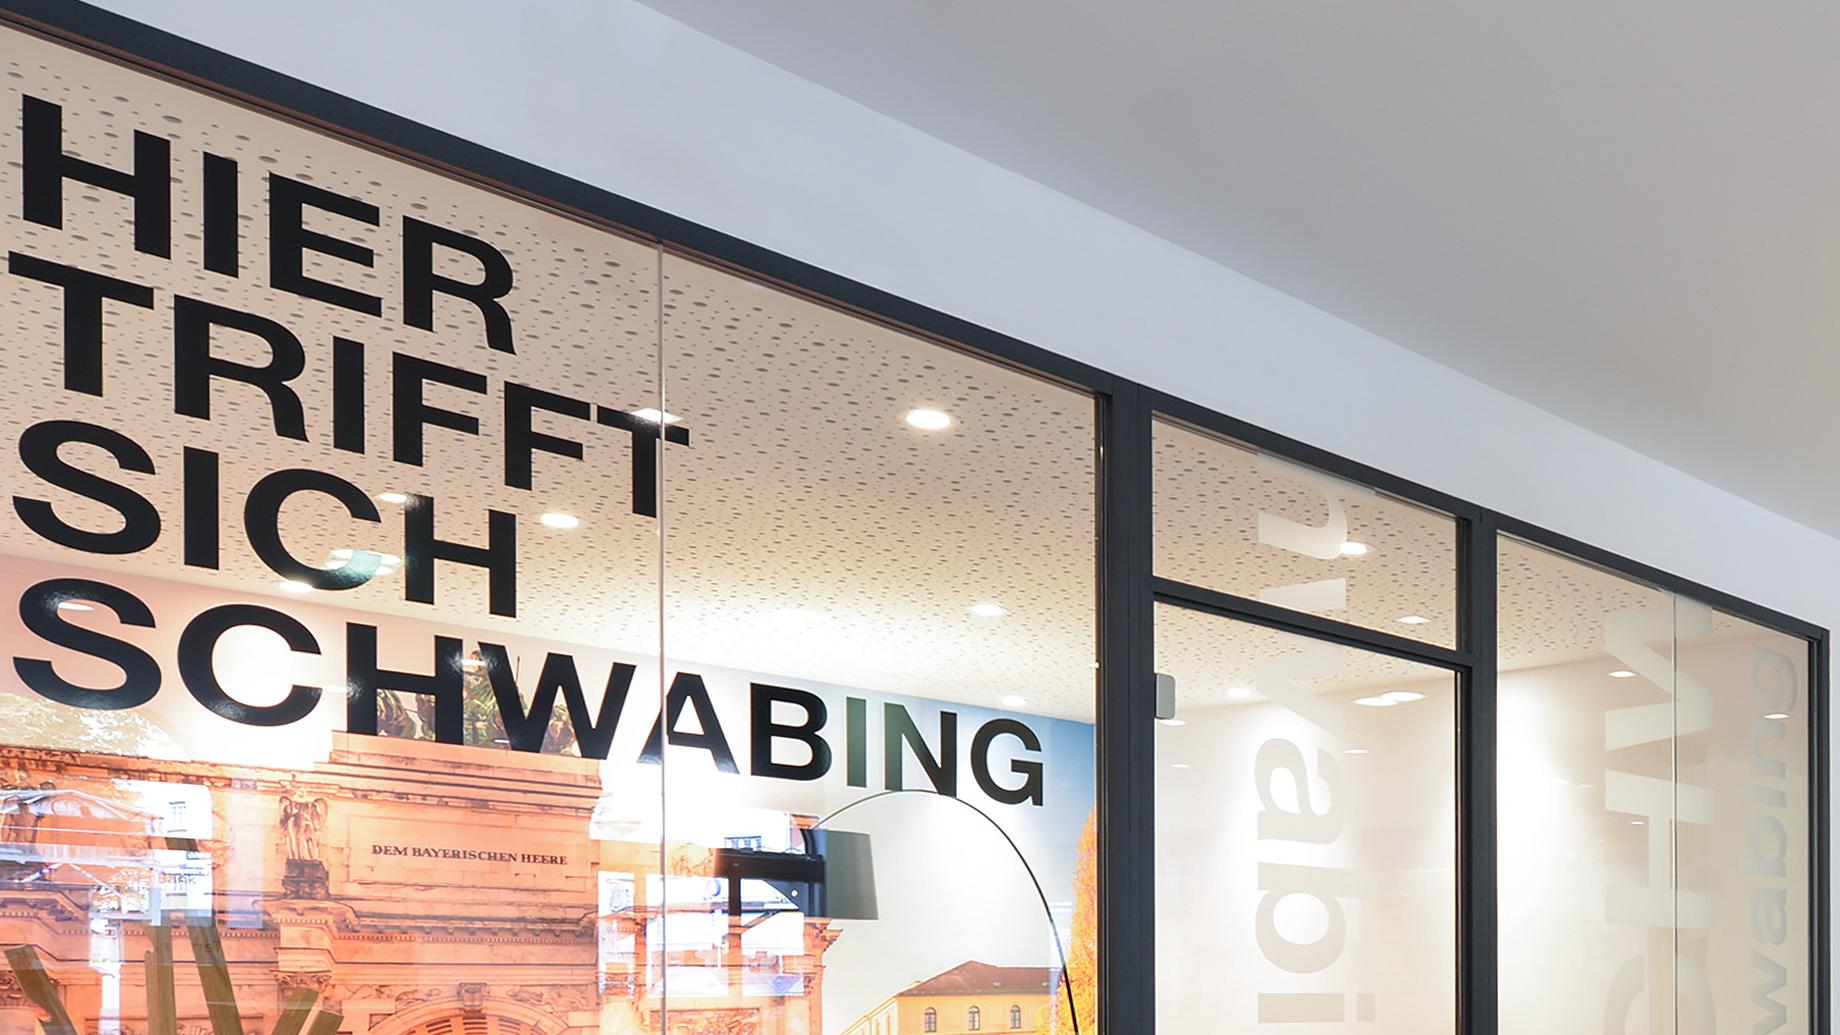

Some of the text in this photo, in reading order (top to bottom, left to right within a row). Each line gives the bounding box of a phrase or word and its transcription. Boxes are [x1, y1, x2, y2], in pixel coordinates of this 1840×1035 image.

[22, 94, 517, 355] HIER
[7, 250, 690, 519] TRIFFT
[13, 419, 518, 619] SICH
[13, 578, 1044, 807] SCHWABING
[372, 845, 568, 865] DEM BAYERISCHEN HEERE
